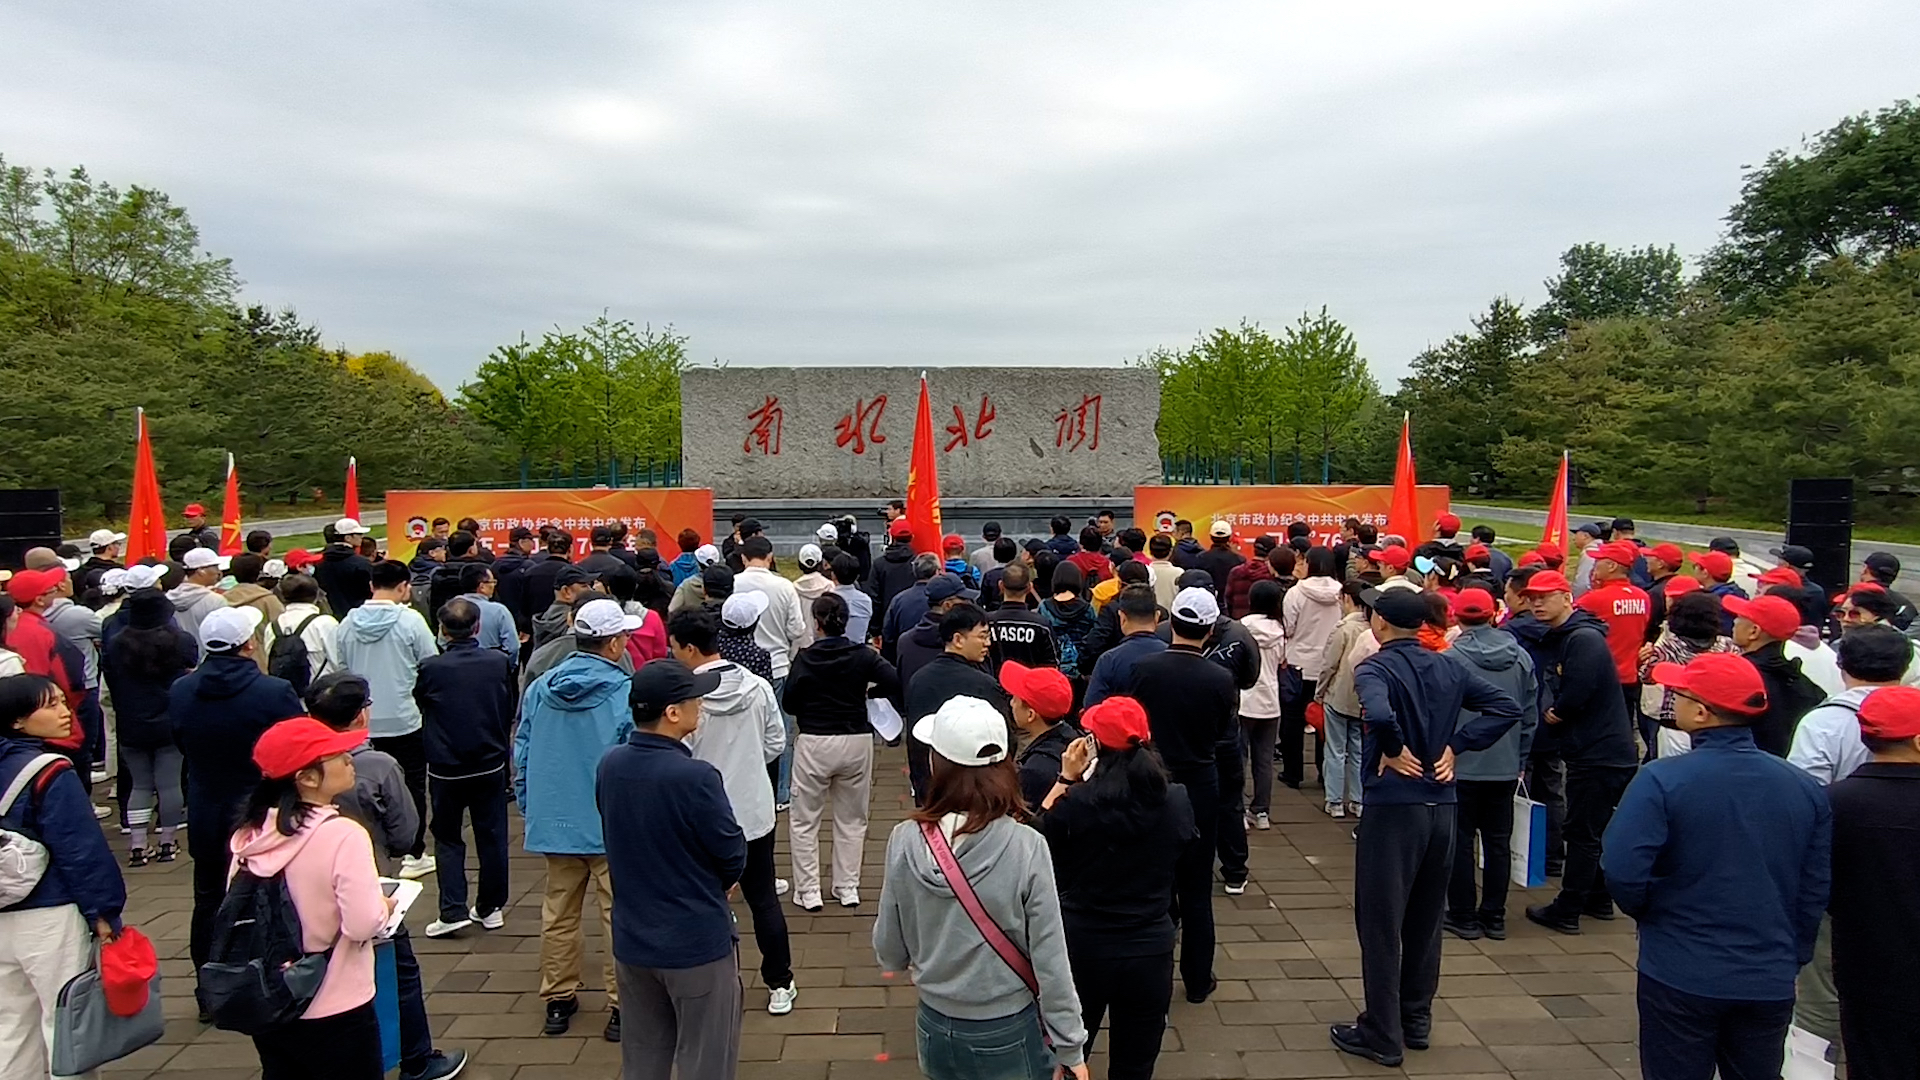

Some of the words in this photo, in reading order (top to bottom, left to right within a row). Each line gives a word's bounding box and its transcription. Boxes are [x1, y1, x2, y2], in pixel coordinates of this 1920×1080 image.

[744, 394, 1101, 454] 南水北调
[478, 517, 647, 531] 京市政协纪念中共中央发布
[1613, 599, 1646, 615] CHINA
